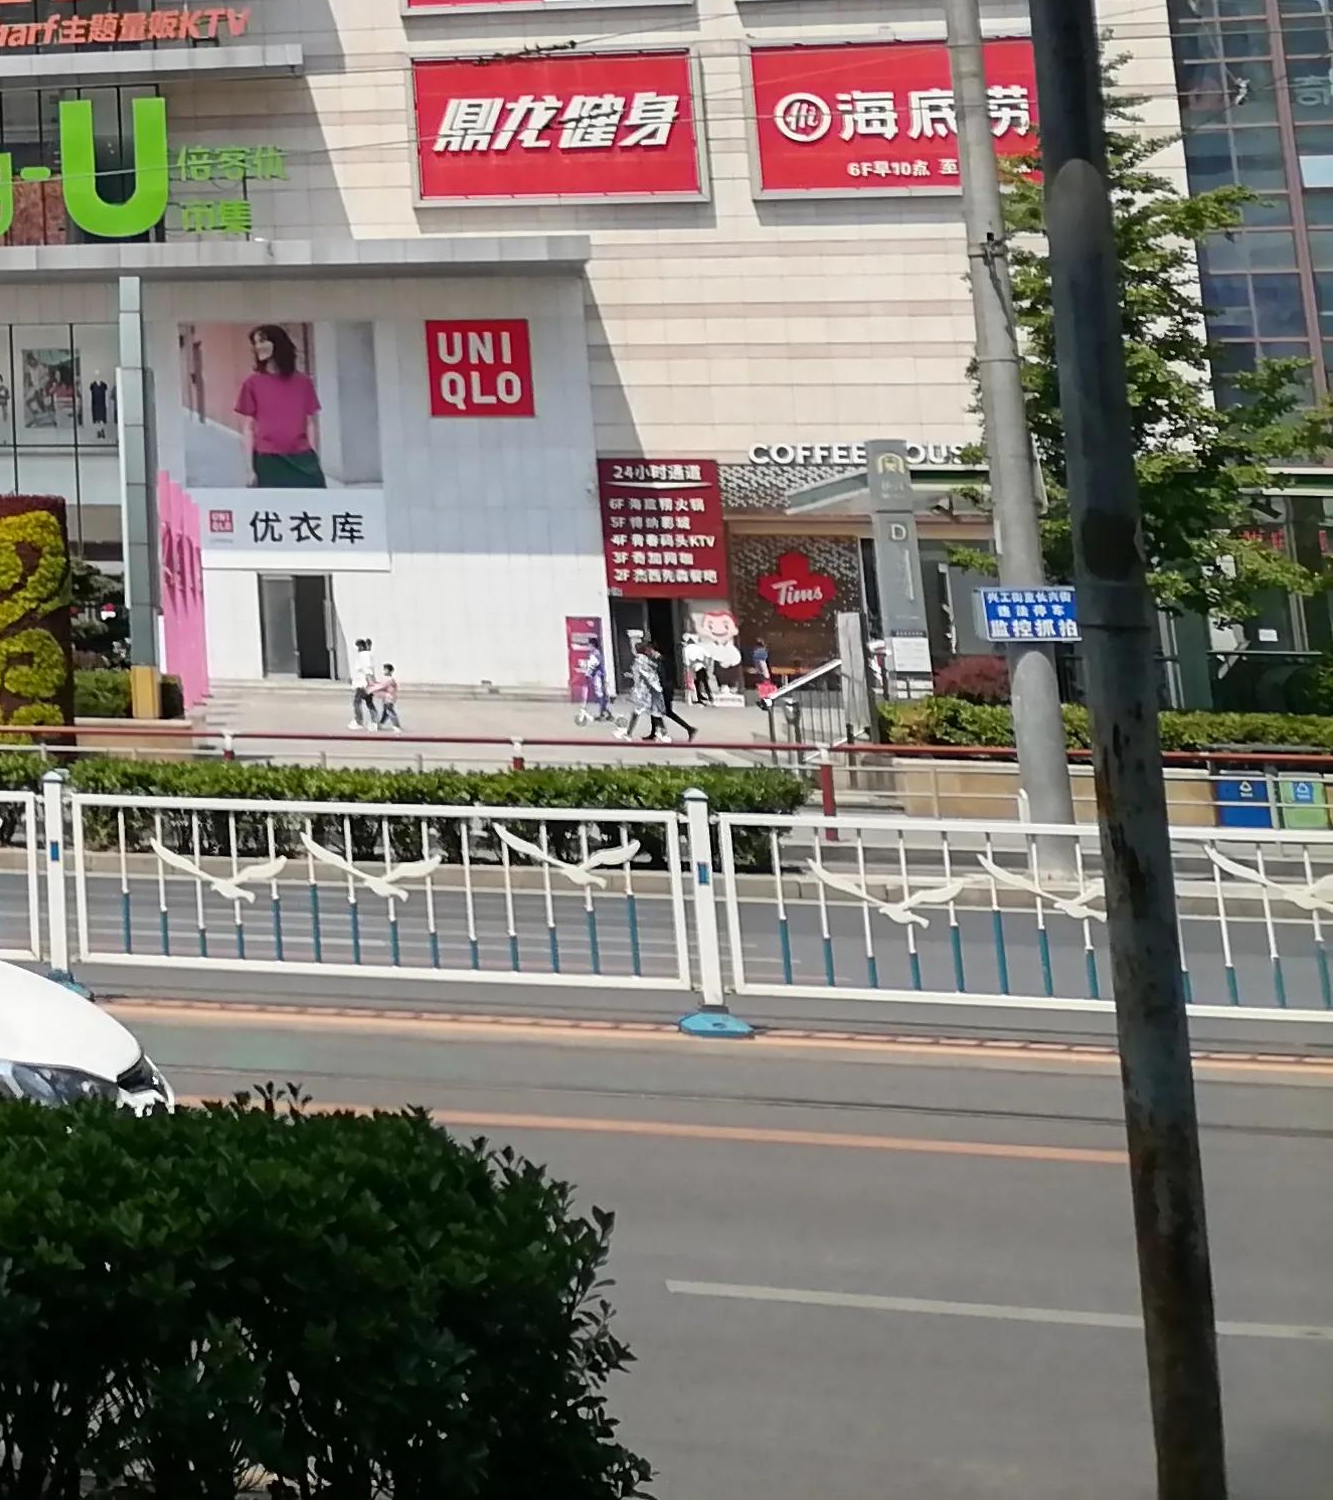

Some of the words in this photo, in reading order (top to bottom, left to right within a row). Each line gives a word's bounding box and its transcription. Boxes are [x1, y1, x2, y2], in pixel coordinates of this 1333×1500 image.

[437, 331, 512, 365] UNI
[441, 371, 523, 409] QLO
[749, 442, 867, 465] COFFEE
[250, 511, 365, 544] 优衣库
[891, 523, 907, 541] D
[771, 579, 823, 606] Tims
[989, 618, 1079, 638] 监控抓拍
